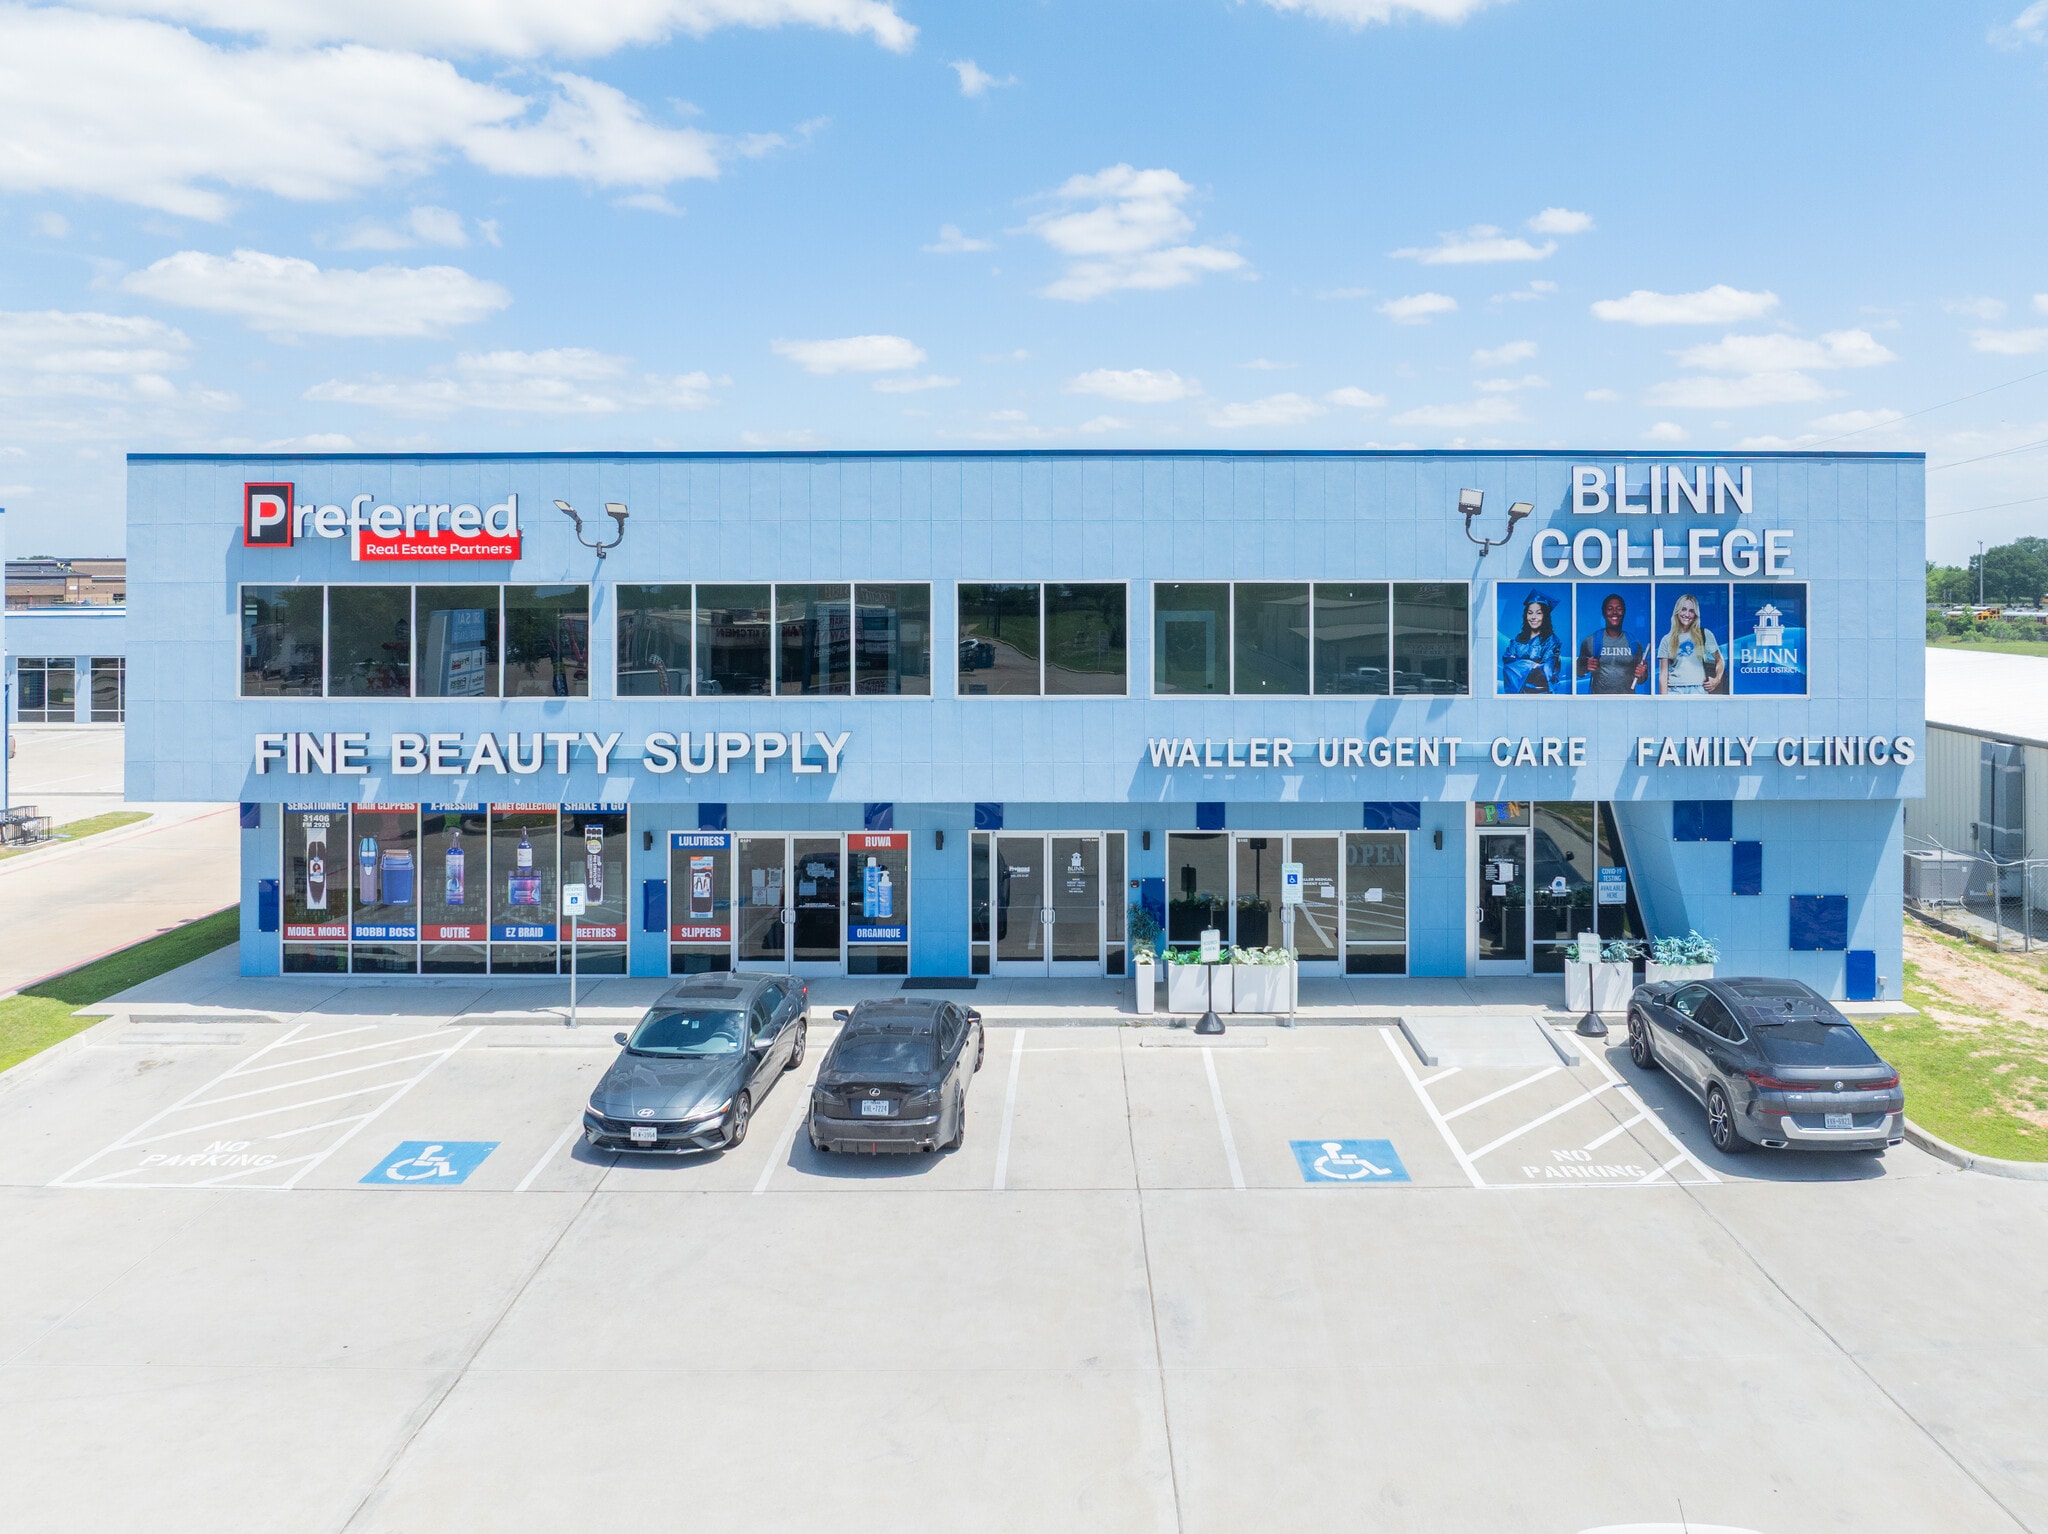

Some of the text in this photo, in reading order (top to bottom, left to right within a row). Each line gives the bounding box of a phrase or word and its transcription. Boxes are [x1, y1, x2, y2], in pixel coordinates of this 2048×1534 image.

[1572, 465, 1753, 514] BLINN
[251, 493, 519, 561] Preferred
[366, 543, 512, 555] Real Estate Partners
[1532, 528, 1795, 576] COLLEGE
[1601, 647, 1632, 656] BLINN
[1741, 649, 1798, 664] BLINN
[254, 731, 852, 776] FINE BEAUTY SUPPLY
[1149, 737, 1588, 768] WALLER URGENT CARE
[1636, 736, 1915, 767] FAMILY CLINICS
[357, 802, 415, 811] HAIR CLIPPERS
[430, 802, 479, 811] X-PRESSION
[492, 802, 557, 811] JANET COLLECTION
[564, 802, 597, 811] SHAKE
[611, 802, 625, 811] GO
[1475, 801, 1520, 823] OPEN
[303, 814, 330, 822] 31406
[678, 836, 725, 846] LULUTRESS
[865, 836, 892, 847] RUWA
[1347, 843, 1405, 866] OPEN
[287, 926, 347, 937] MODEL MODEL
[356, 926, 416, 937] BOBBI BOSS
[440, 926, 471, 938] OUTRE
[505, 926, 544, 938] EZ BRAID
[573, 927, 617, 938] REETRESS
[681, 927, 722, 938] SLIPPERS
[856, 928, 901, 938] ORGANIQUE
[202, 1140, 255, 1153] NO
[139, 1154, 278, 1167] PARKING
[1553, 1149, 1593, 1162] NO
[1521, 1164, 1648, 1179] PARKING
